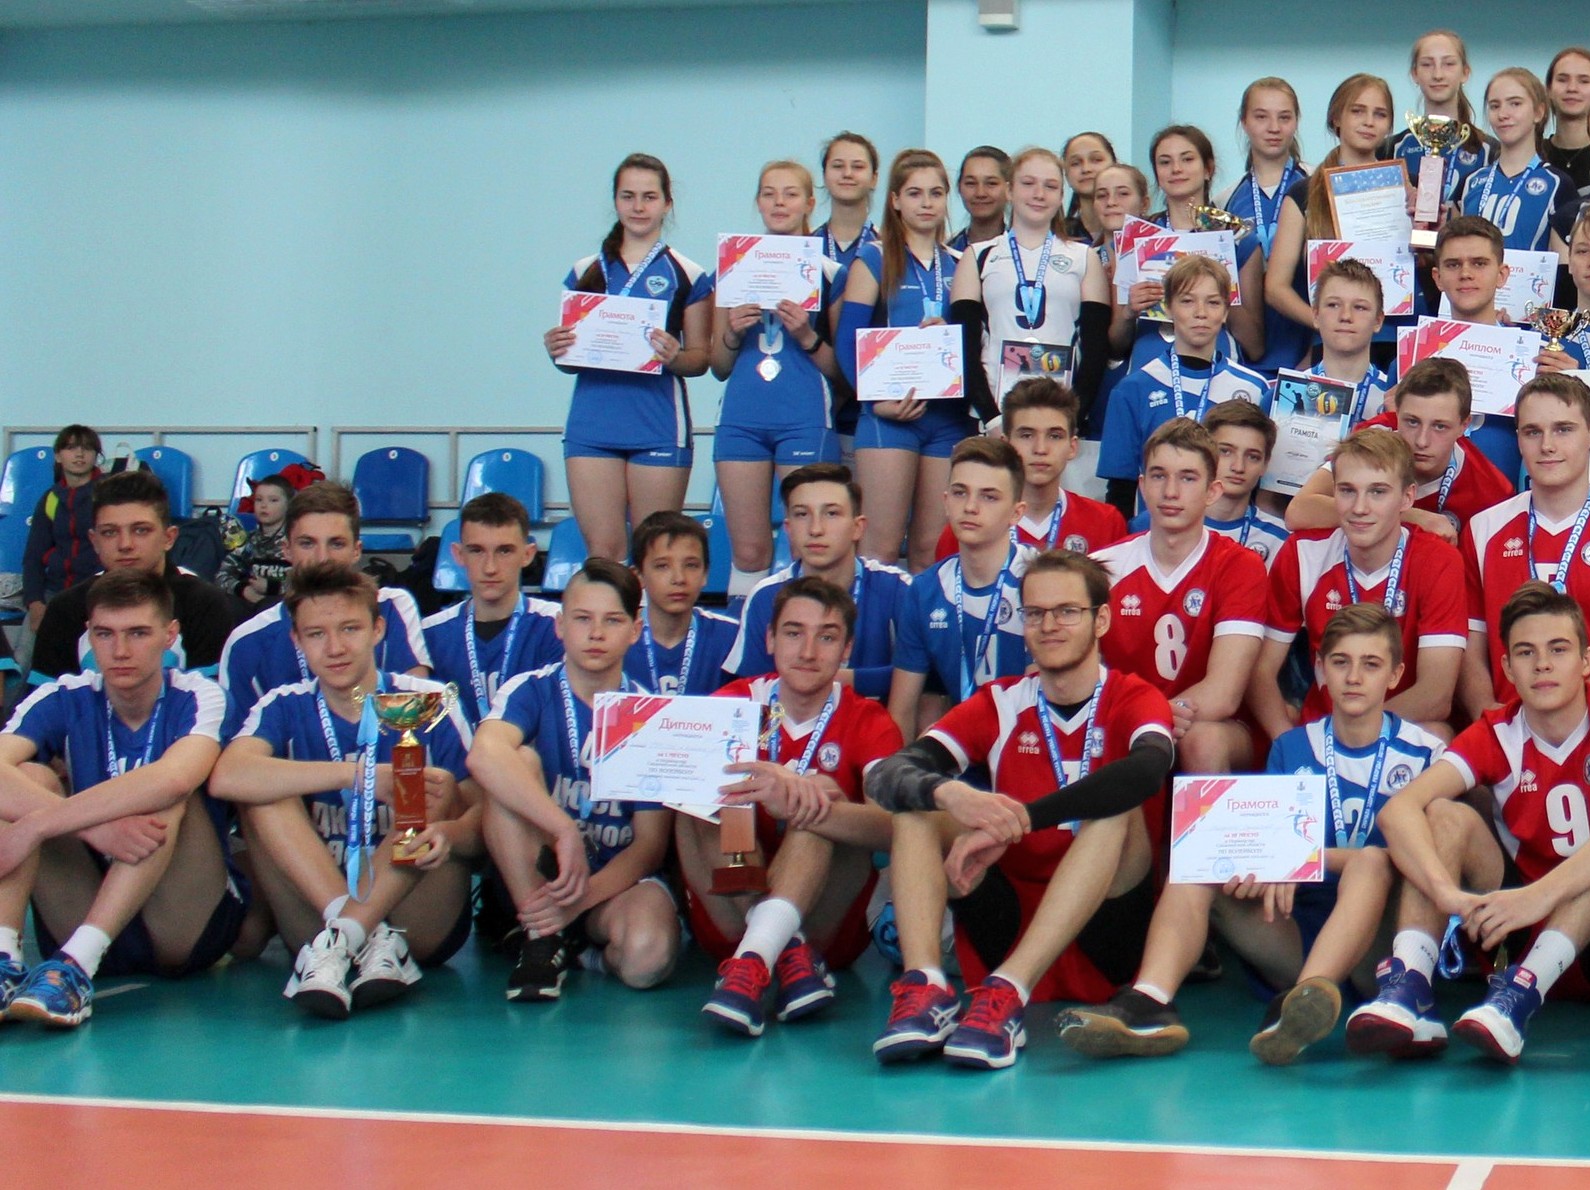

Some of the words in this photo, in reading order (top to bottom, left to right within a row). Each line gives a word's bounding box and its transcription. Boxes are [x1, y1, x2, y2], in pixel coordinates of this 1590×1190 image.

[1482, 194, 1522, 236] 10
[755, 250, 790, 259] Грамота
[599, 309, 635, 321] Грамота
[895, 343, 931, 351] Грамота
[1459, 340, 1501, 354] Диплом
[1290, 428, 1318, 439] ГРАМОТА
[1154, 613, 1188, 681] 8
[658, 718, 712, 731] Диплом
[1520, 783, 1537, 793] rrea
[1227, 799, 1279, 812] Грамота
[1546, 783, 1590, 857] 9
